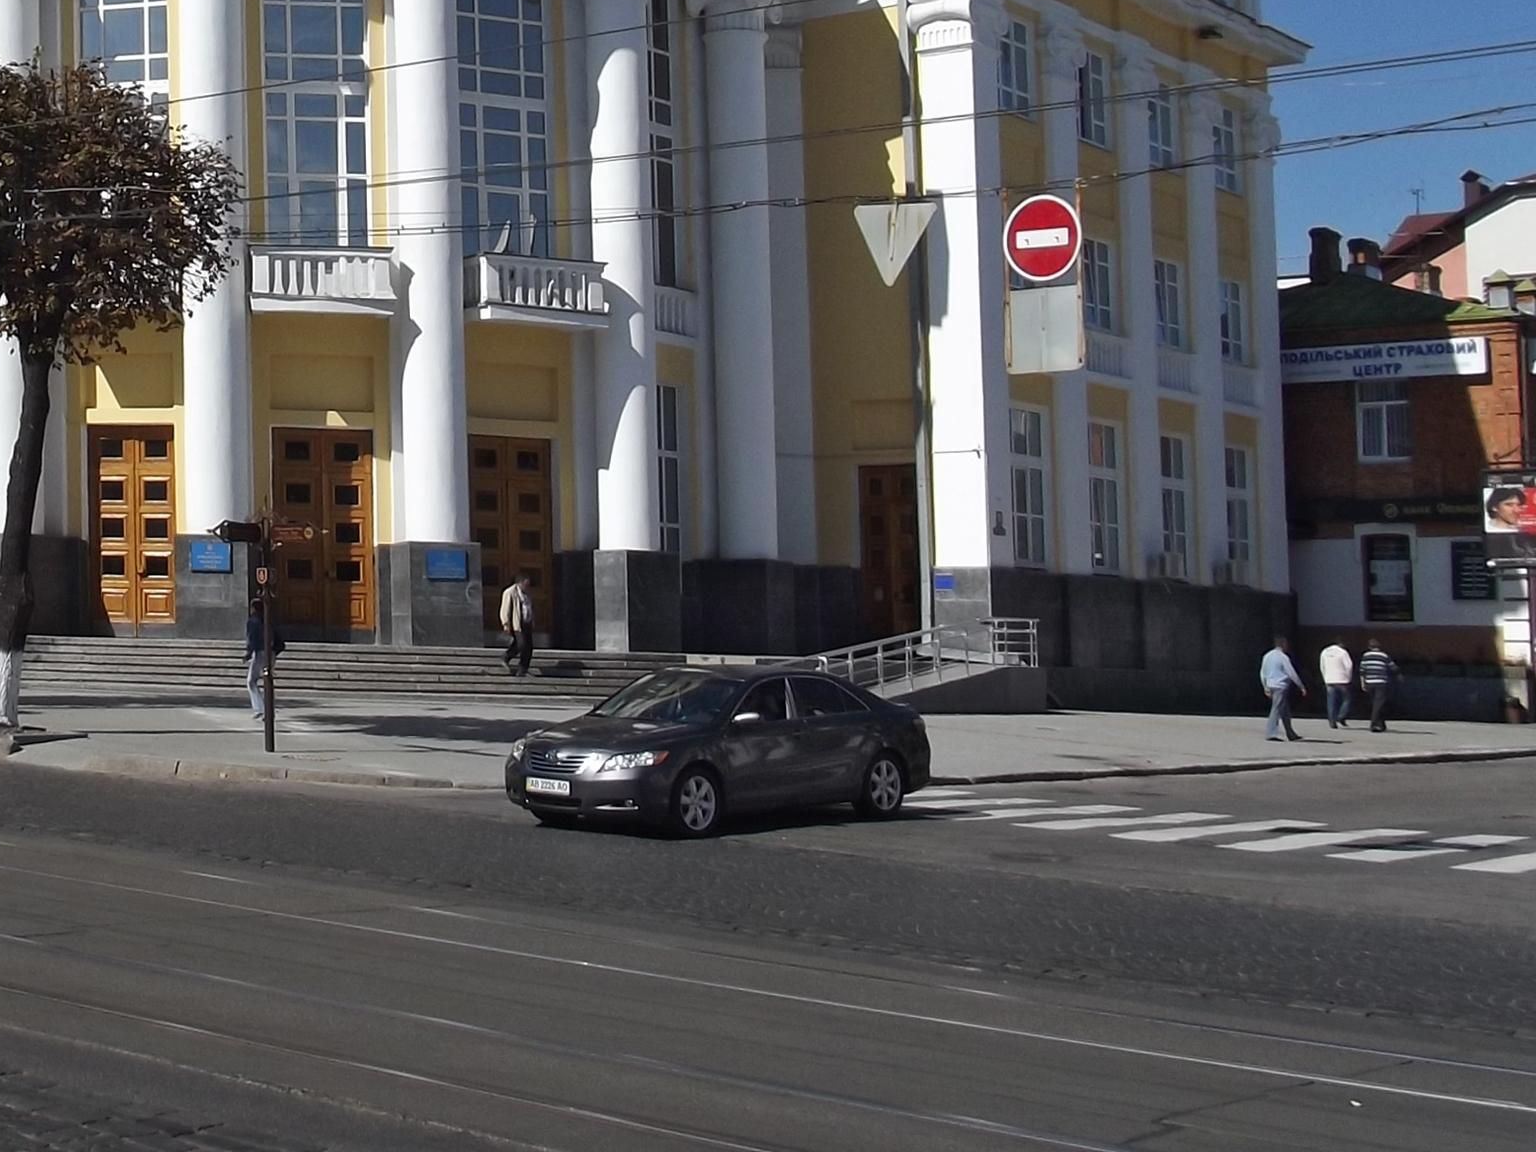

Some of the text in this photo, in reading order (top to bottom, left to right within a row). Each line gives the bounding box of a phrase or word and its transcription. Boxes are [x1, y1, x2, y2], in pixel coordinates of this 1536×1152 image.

[1280, 339, 1477, 364] ПОДІЛЬСЬКИЙ СТРАХОВИЙ
[1353, 363, 1402, 377] ЦЕНТР
